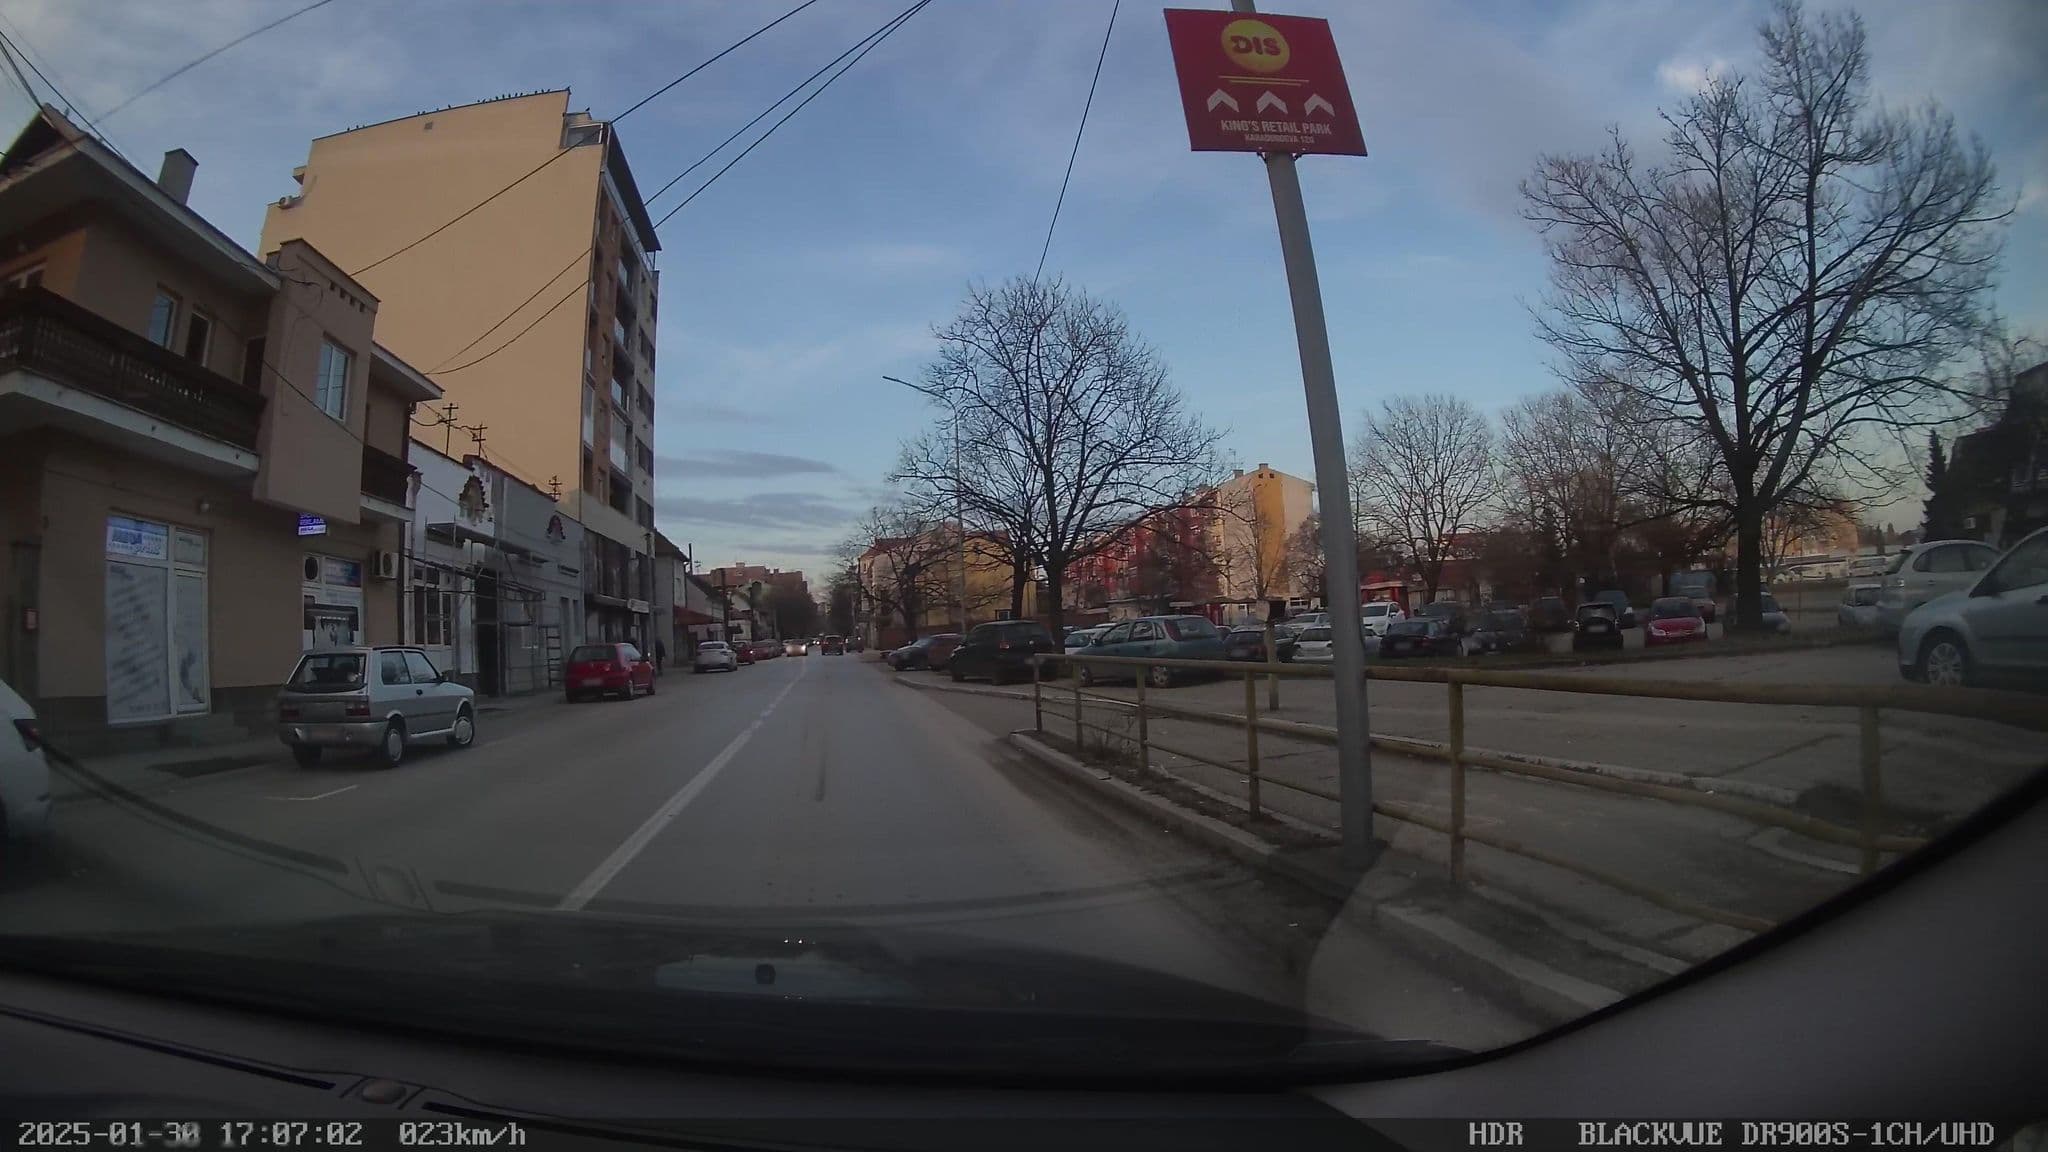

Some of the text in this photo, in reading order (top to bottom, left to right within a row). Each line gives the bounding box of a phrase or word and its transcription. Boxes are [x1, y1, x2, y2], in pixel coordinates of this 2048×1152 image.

[1230, 35, 1281, 56] DIS
[1221, 119, 1332, 135] KING'S RETAIL PARK
